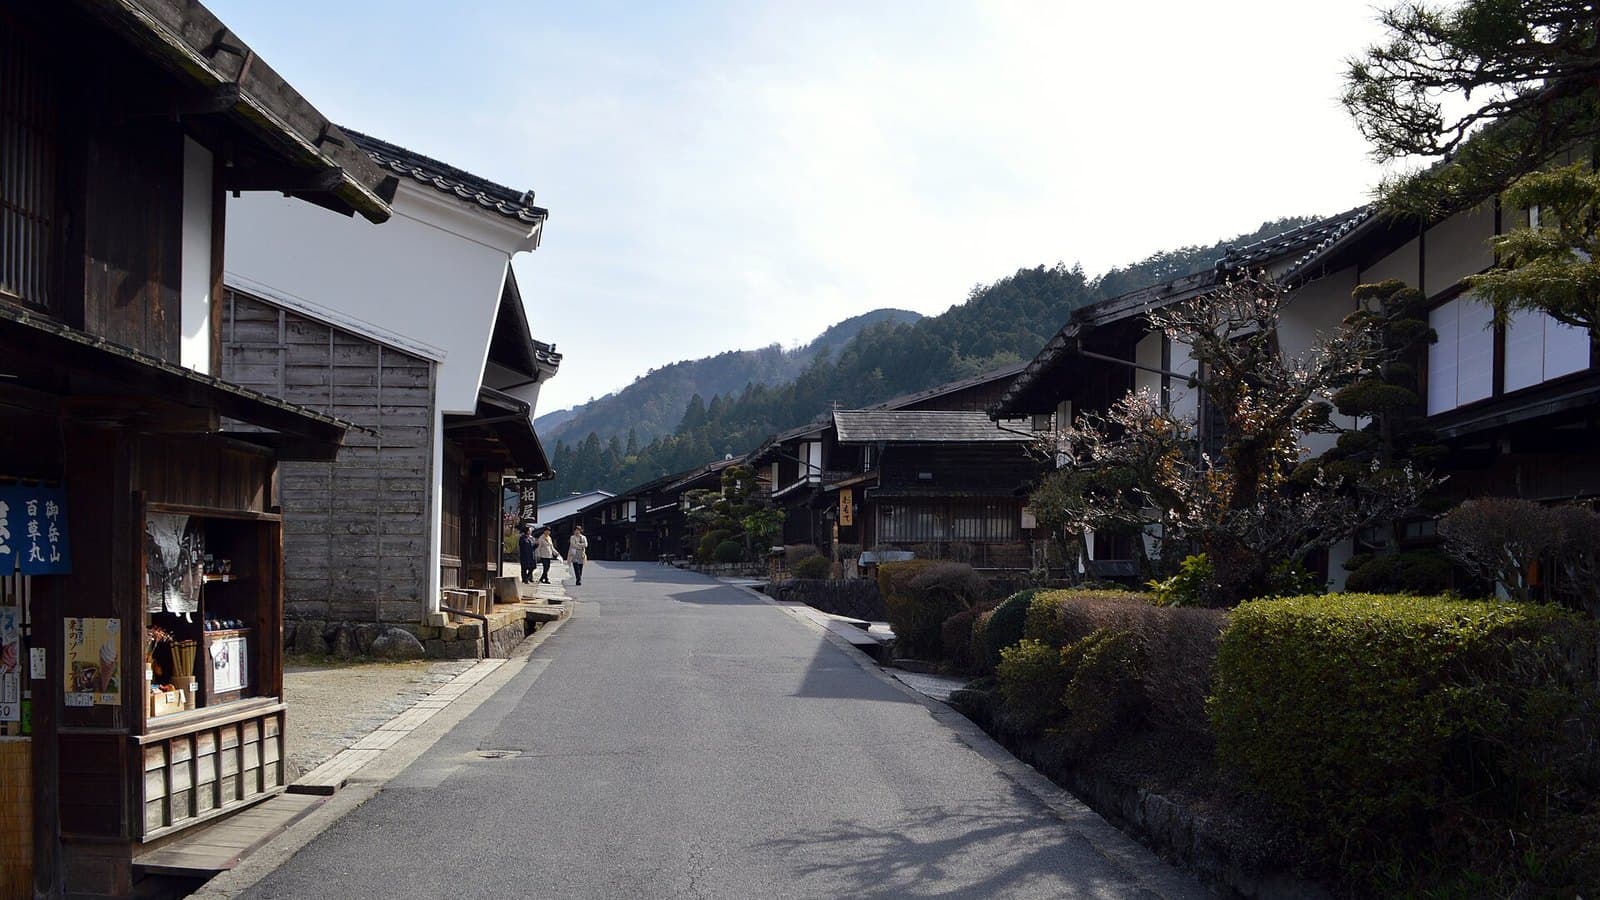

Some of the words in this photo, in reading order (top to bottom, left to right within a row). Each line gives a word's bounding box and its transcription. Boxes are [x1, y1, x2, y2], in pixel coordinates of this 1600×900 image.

[25, 499, 46, 562] 百草丸
[45, 500, 61, 562] 御岳山
[521, 487, 536, 520] 柏屋
